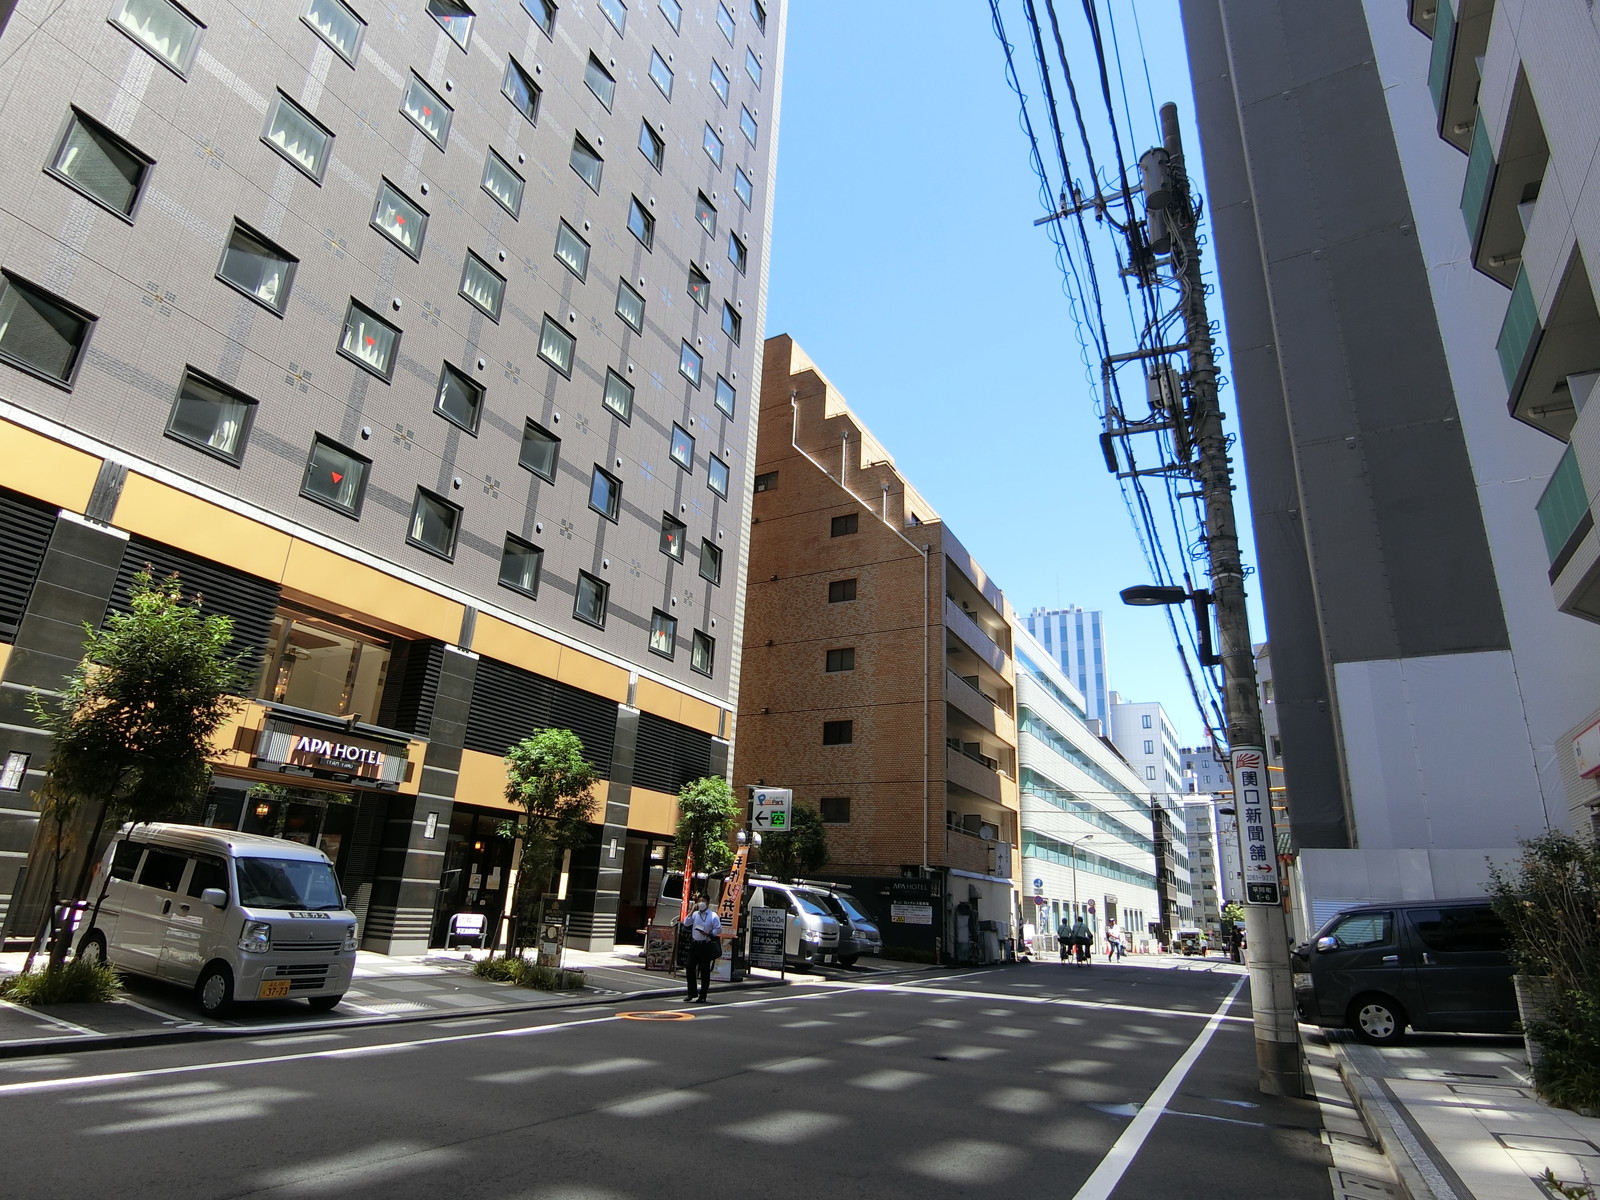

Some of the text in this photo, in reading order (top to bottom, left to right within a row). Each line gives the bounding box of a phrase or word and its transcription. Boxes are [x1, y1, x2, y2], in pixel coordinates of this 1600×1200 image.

[297, 736, 332, 756] APA
[333, 743, 384, 765] HOTEL
[1241, 771, 1267, 861] 関口新聞舗
